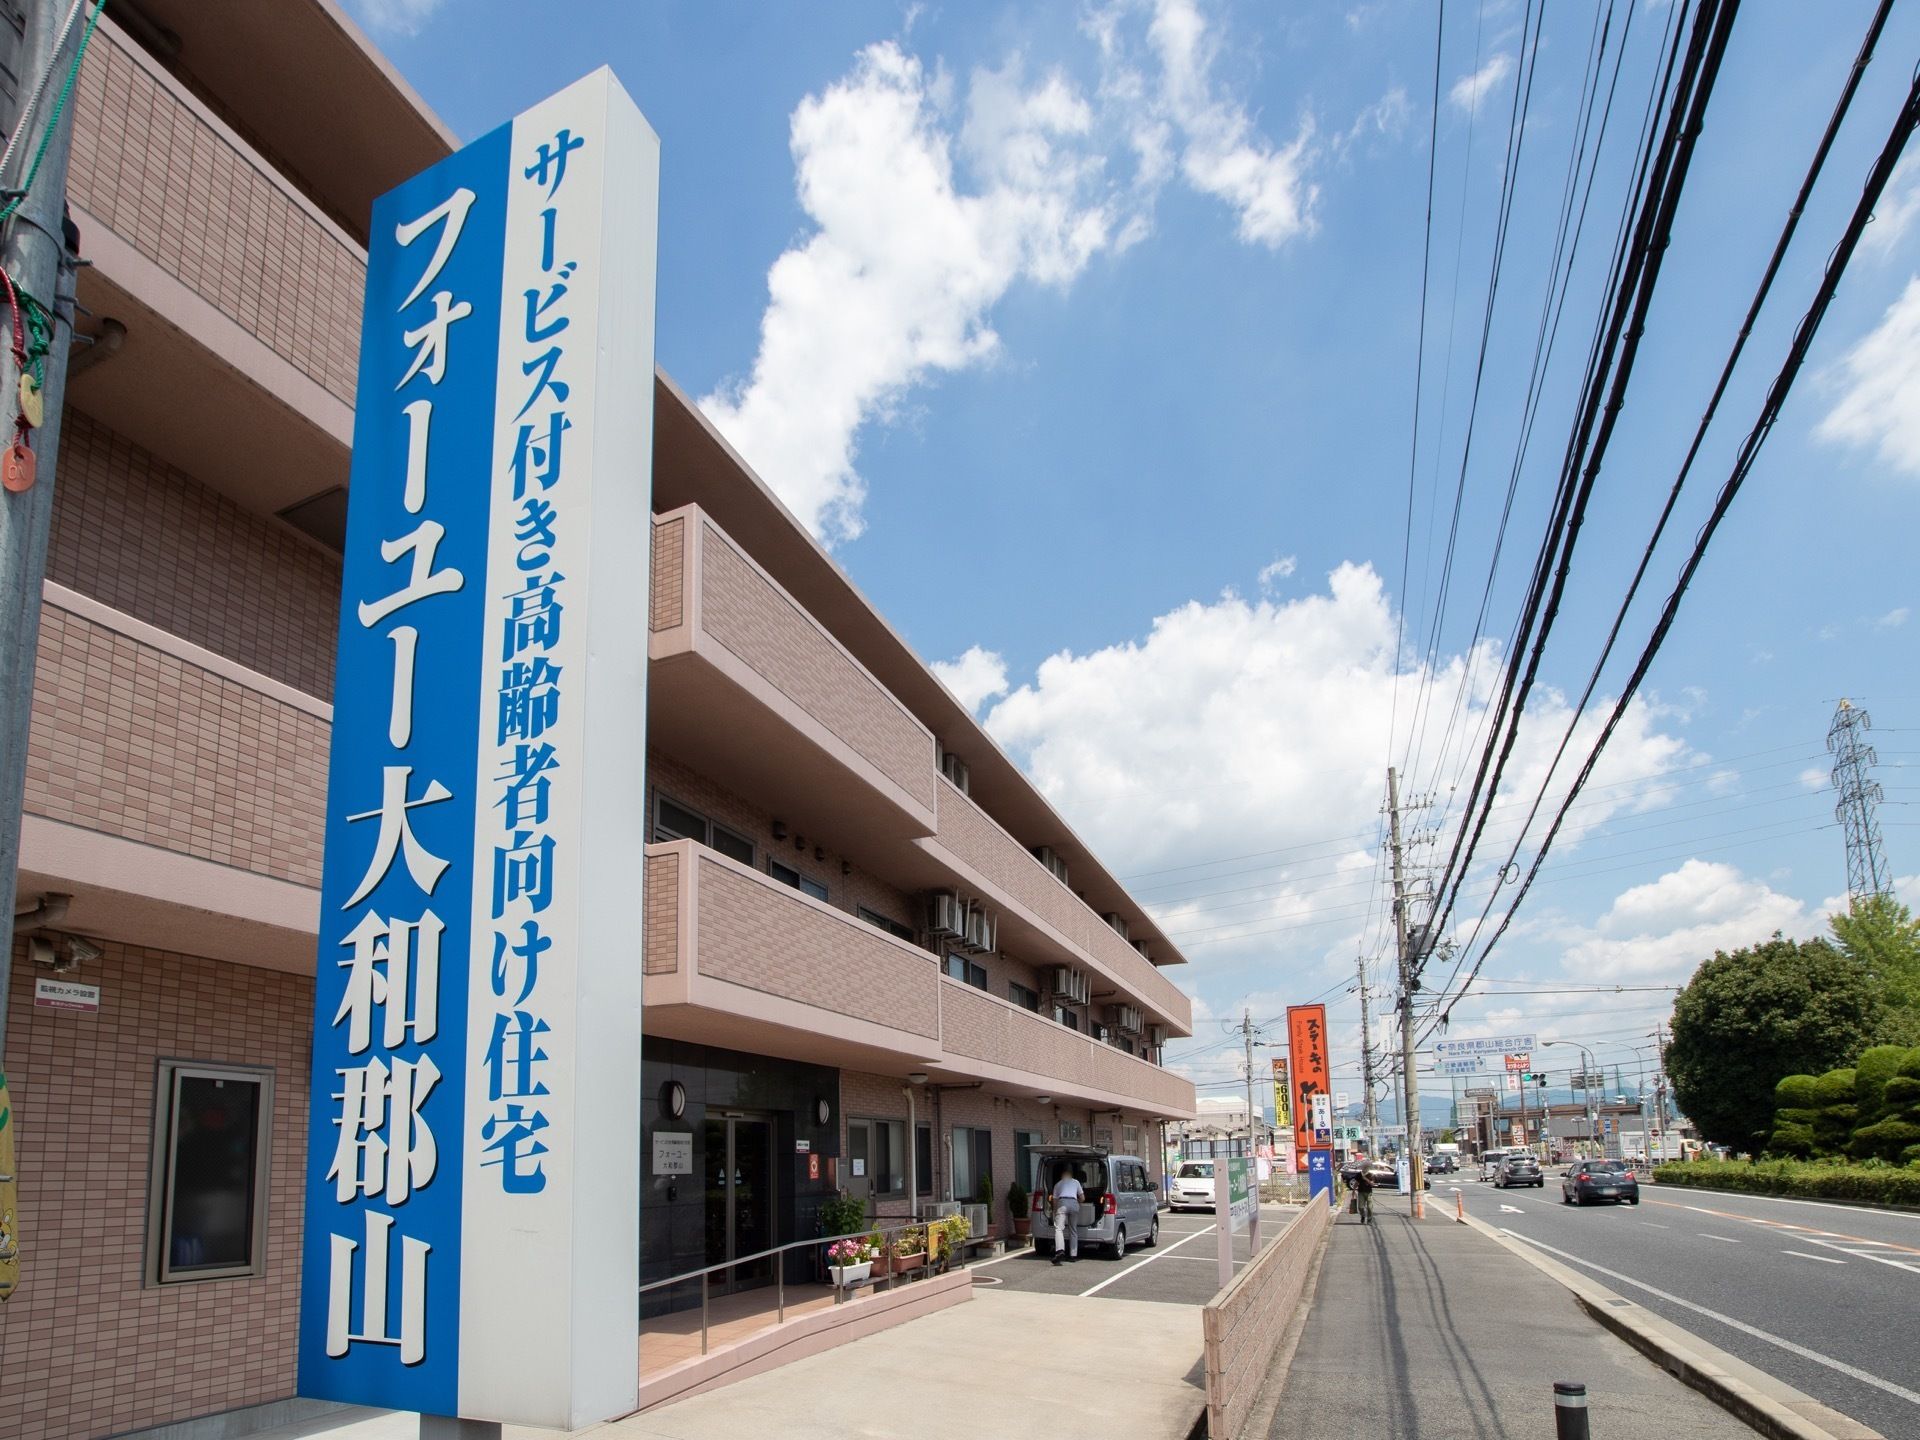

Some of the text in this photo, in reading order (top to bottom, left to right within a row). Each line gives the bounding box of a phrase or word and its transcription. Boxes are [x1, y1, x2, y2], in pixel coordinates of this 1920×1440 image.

[480, 129, 584, 1194] サービス付き高齢者向け住宅
[325, 187, 476, 1365] フォーユー大和郡山
[40, 984, 96, 999] 監視カメラ設置
[1307, 1019, 1322, 1073] ステーキの
[1448, 1037, 1533, 1051] 奈良県郡山総合庁舎
[1333, 1127, 1359, 1139] 看板
